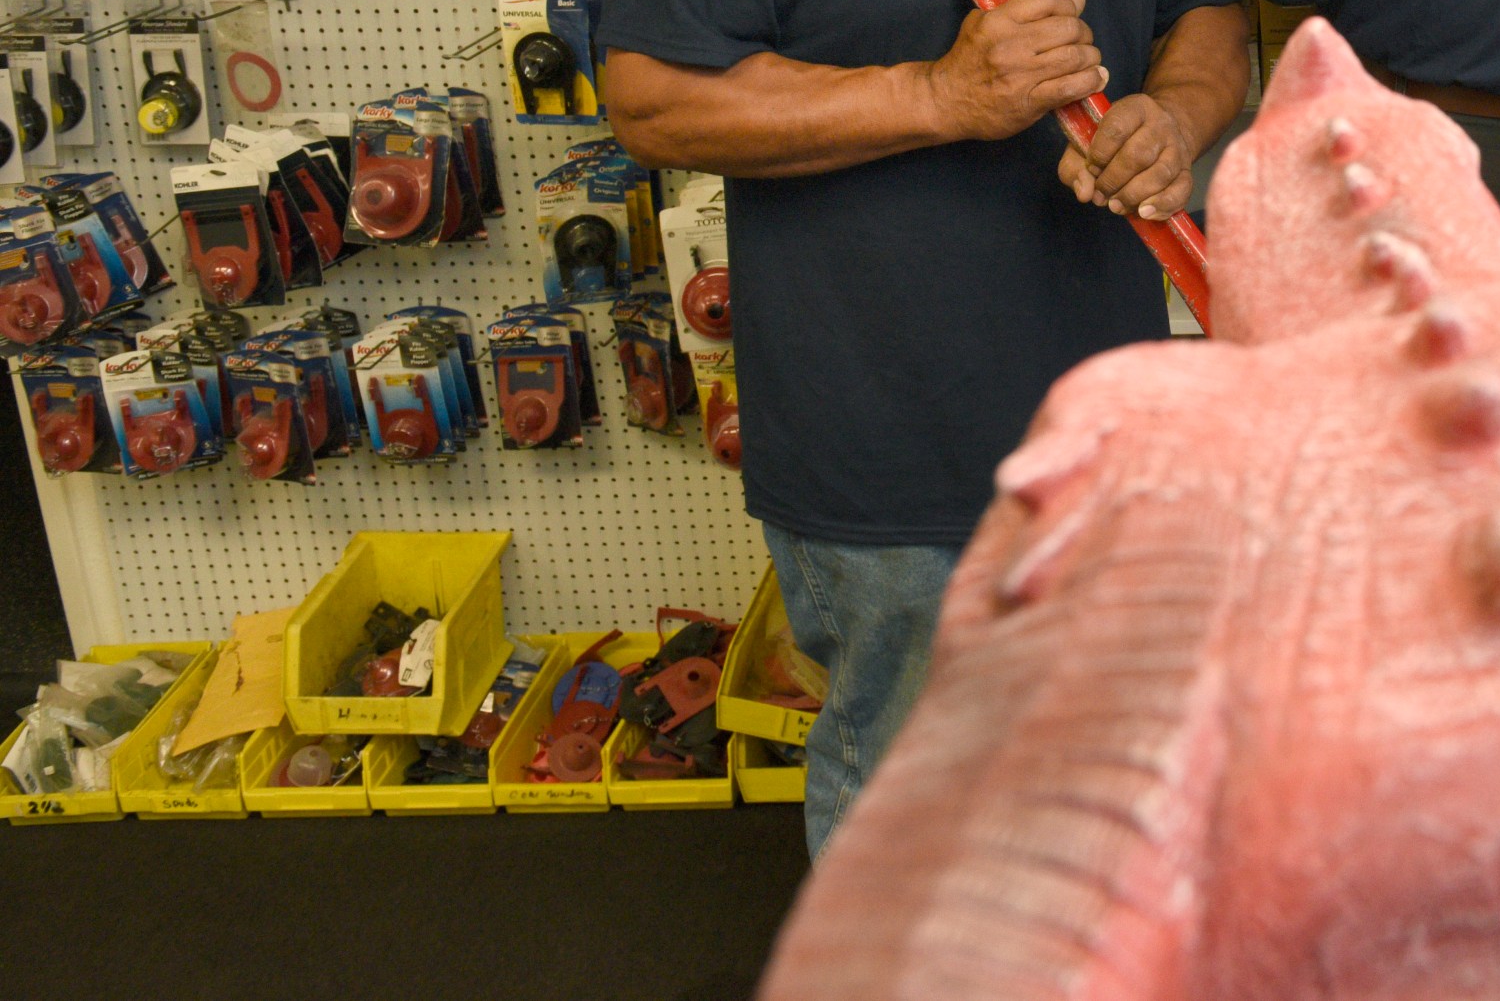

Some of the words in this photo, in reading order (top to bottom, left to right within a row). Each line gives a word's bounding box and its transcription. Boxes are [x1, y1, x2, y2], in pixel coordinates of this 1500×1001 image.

[557, 0, 576, 7] Basic
[502, 10, 544, 18] UNIVERSAL
[362, 105, 394, 119] korky
[174, 181, 199, 189] KOHLER
[539, 181, 577, 194] korky
